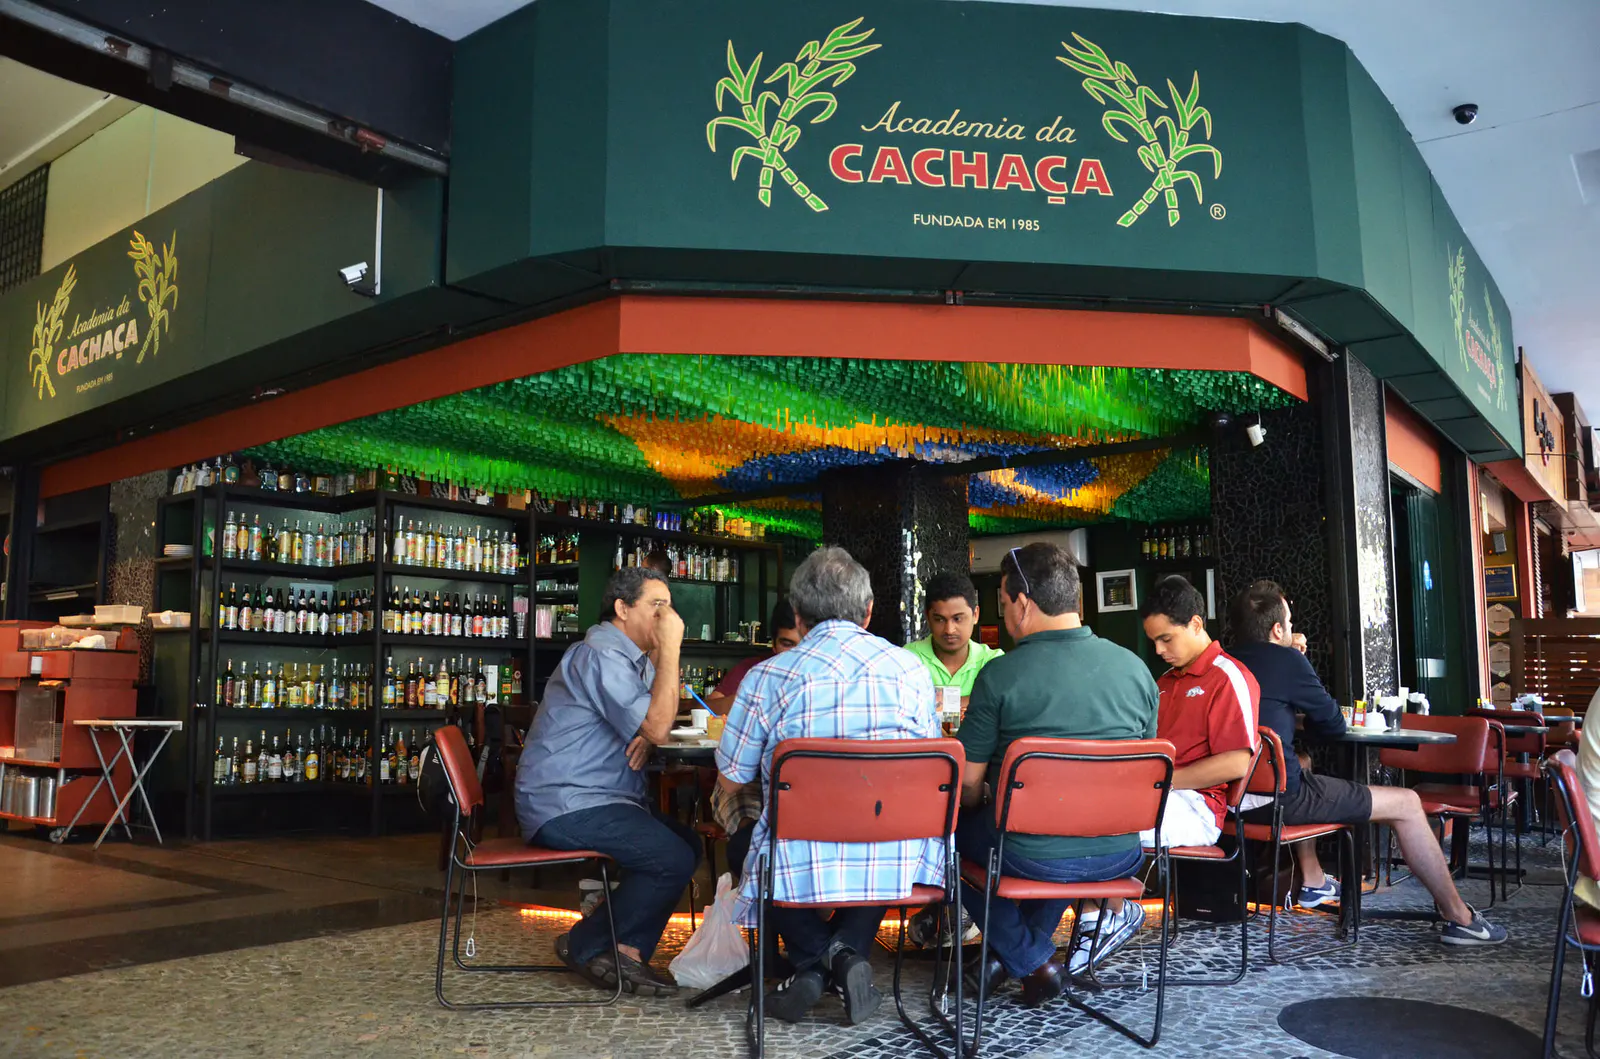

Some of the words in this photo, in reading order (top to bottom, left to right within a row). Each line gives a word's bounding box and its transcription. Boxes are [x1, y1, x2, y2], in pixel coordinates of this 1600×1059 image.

[861, 101, 1025, 140] Academia
[1035, 116, 1077, 144] da
[828, 143, 1114, 205] CACHAÇA
[913, 213, 984, 229] FUNDADA
[988, 217, 1006, 230] EM
[1011, 218, 1040, 231] 1985
[67, 306, 115, 340] Academia
[116, 294, 130, 317] da
[58, 319, 138, 375] CACHAÇA
